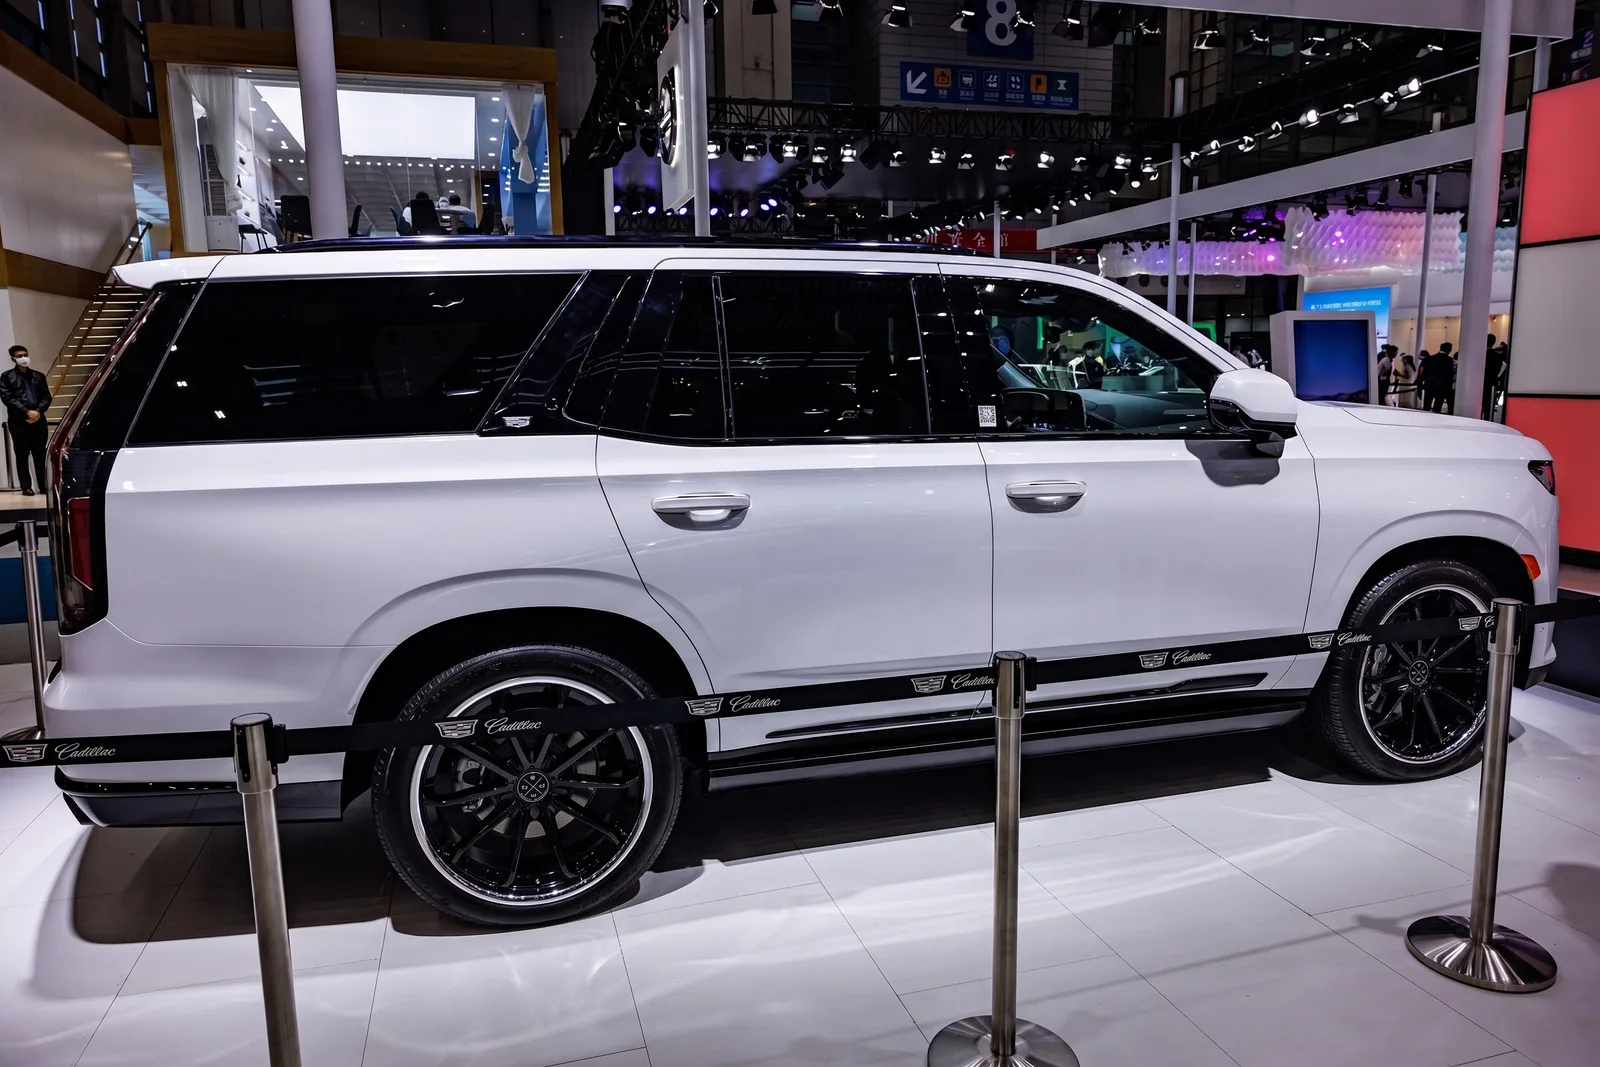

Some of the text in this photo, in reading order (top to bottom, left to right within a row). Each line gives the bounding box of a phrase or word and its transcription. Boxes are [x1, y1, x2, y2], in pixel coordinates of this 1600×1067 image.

[985, 0, 1017, 46] 8
[1337, 631, 1372, 646] Cadillac
[1172, 650, 1211, 665] Cadillac
[729, 695, 781, 712] Cadillac
[484, 717, 542, 735] Cadillac
[54, 742, 116, 761] Cadillac
